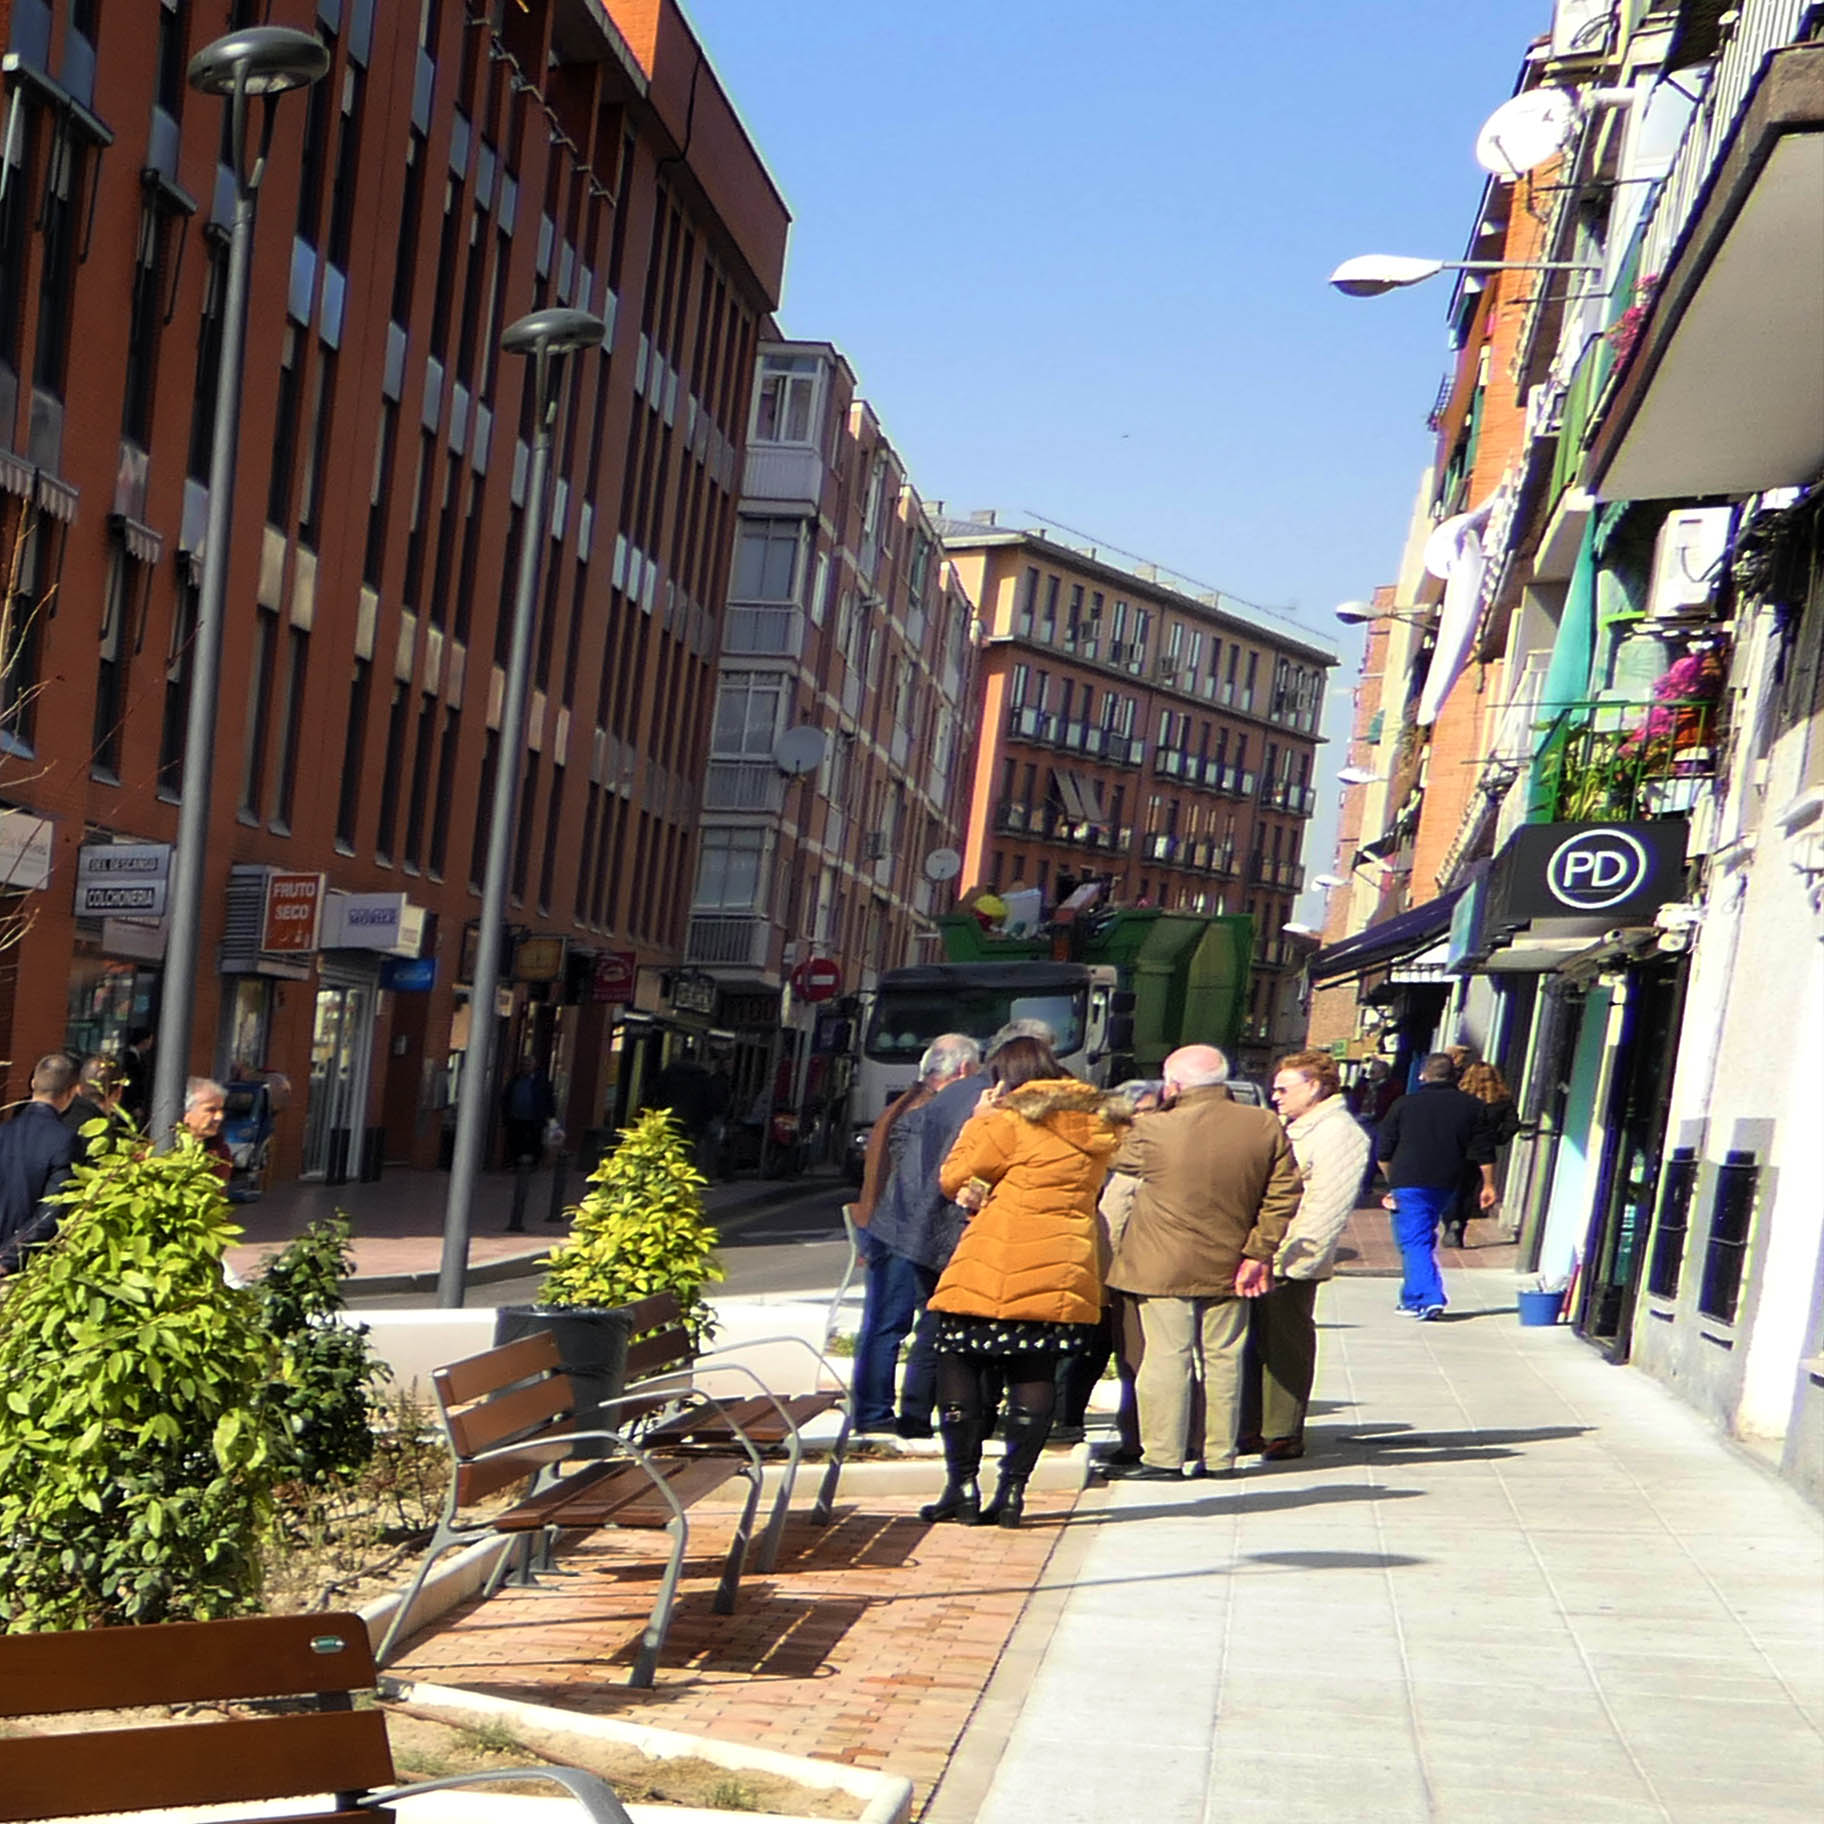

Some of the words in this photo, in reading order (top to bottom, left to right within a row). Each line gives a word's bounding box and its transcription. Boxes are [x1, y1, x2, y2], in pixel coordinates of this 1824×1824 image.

[1563, 850, 1628, 887] PD
[272, 882, 316, 898] FRUTO
[274, 904, 309, 920] SECO
